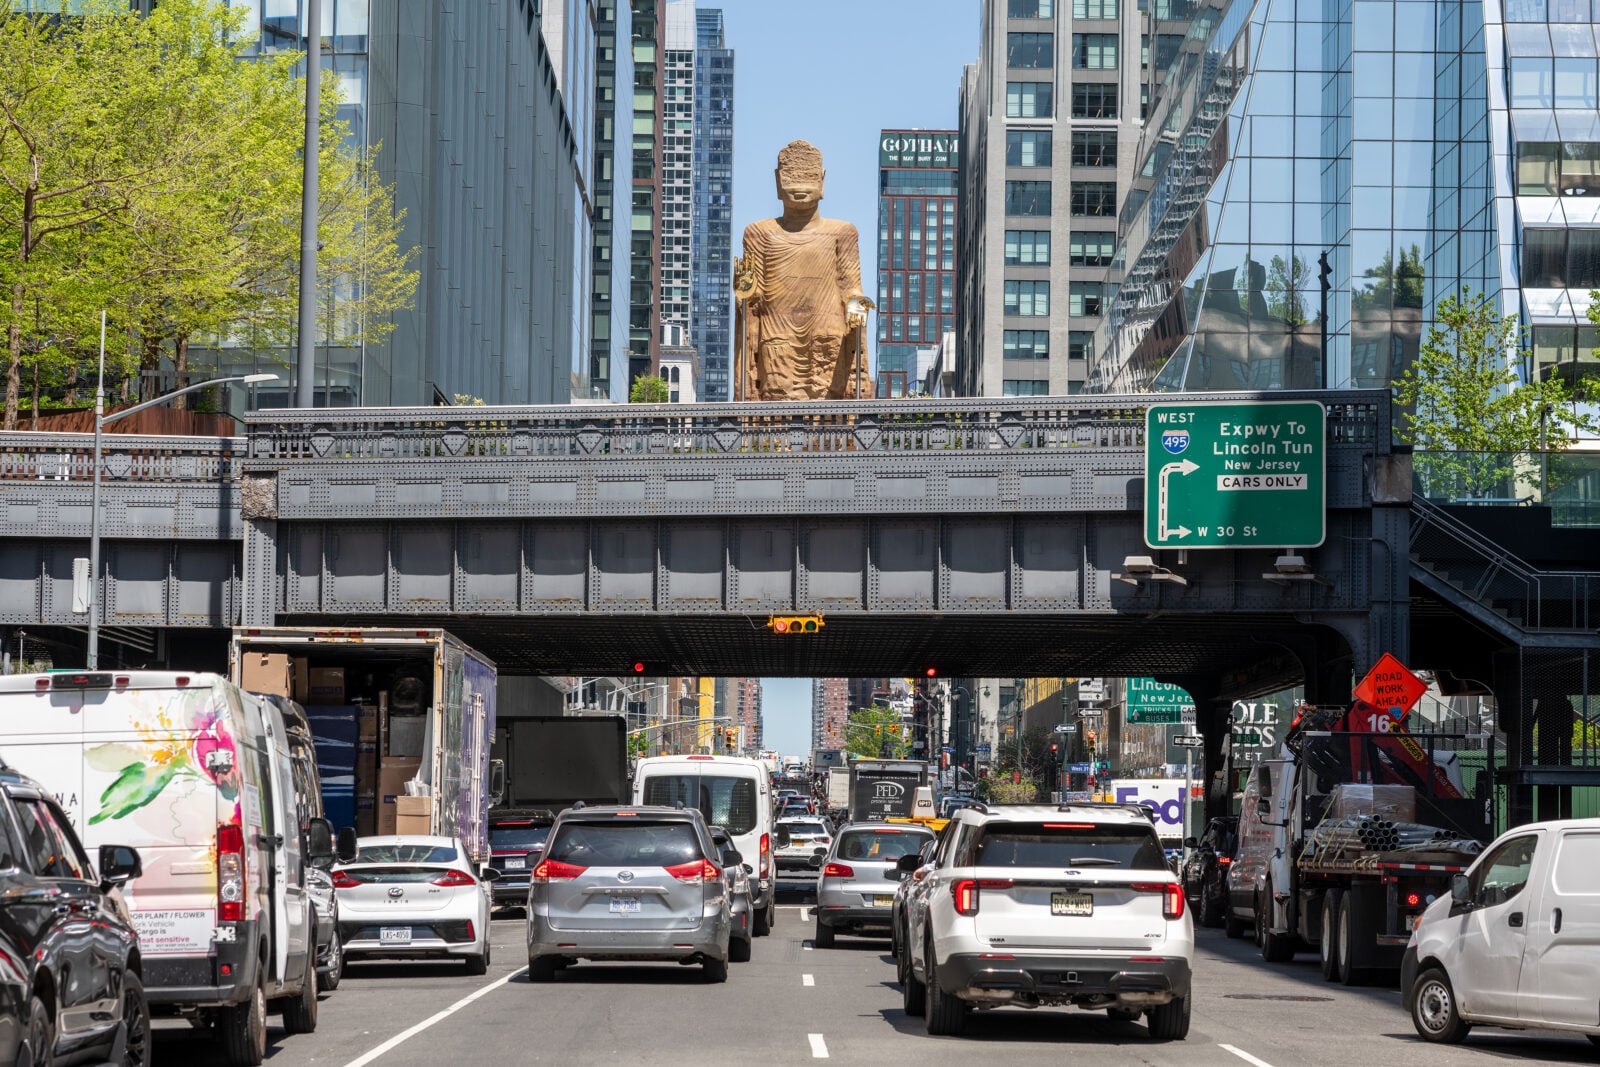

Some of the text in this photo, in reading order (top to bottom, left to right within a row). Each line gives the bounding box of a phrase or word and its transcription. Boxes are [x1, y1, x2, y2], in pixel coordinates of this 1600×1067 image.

[882, 138, 959, 152] GOTHAM
[1157, 412, 1195, 424] WEST
[1220, 421, 1306, 439] Expwy To
[1164, 436, 1187, 448] 495
[1213, 440, 1313, 456] Lincoln Tun
[1224, 459, 1300, 472] New Jersey
[1222, 476, 1302, 488] CARS ONLY
[1197, 525, 1257, 537] W 30 St
[1375, 671, 1403, 682] ROAD
[1141, 694, 1165, 702] New
[1375, 695, 1409, 706] AHEAD
[1232, 700, 1278, 724] OLE
[1367, 713, 1390, 734] 16
[1234, 752, 1262, 761] KET
[876, 785, 898, 797] PFD
[174, 911, 206, 919] FLOWER
[137, 928, 159, 936] Cargo
